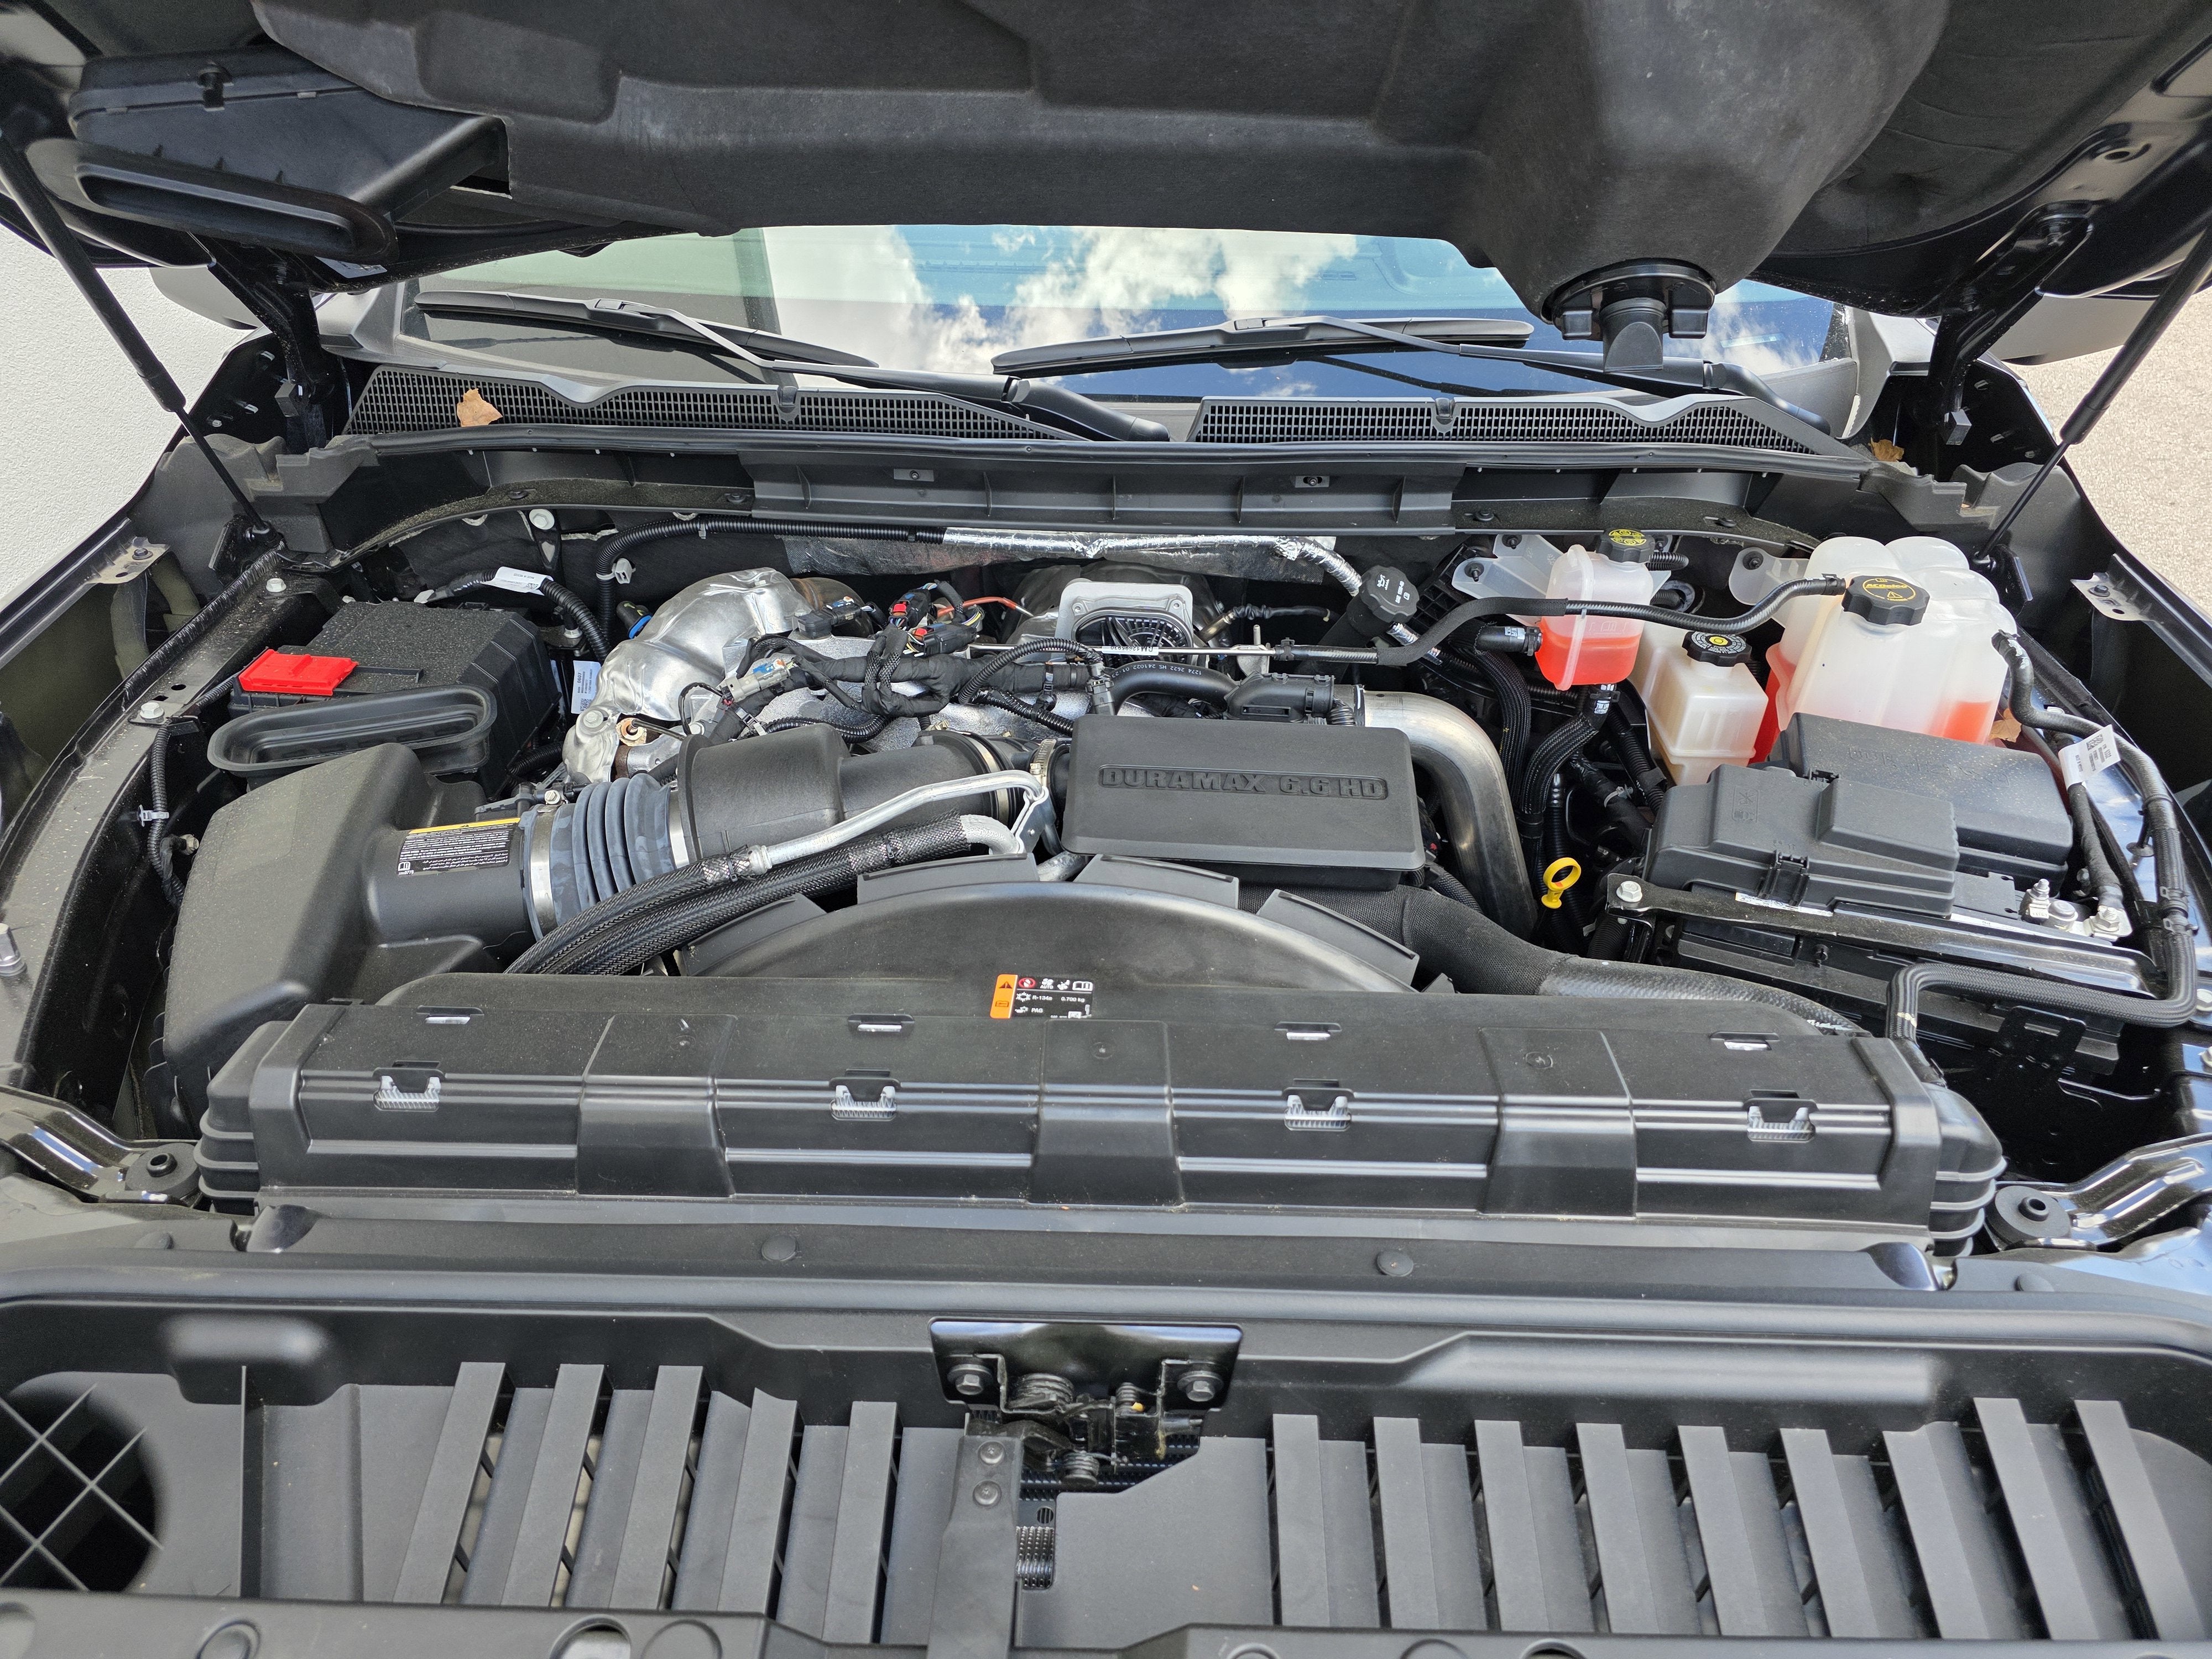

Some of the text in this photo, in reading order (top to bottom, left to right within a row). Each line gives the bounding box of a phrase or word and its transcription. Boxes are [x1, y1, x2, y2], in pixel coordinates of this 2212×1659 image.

[1102, 768, 1384, 799] DURAMAX 6.6 HD
